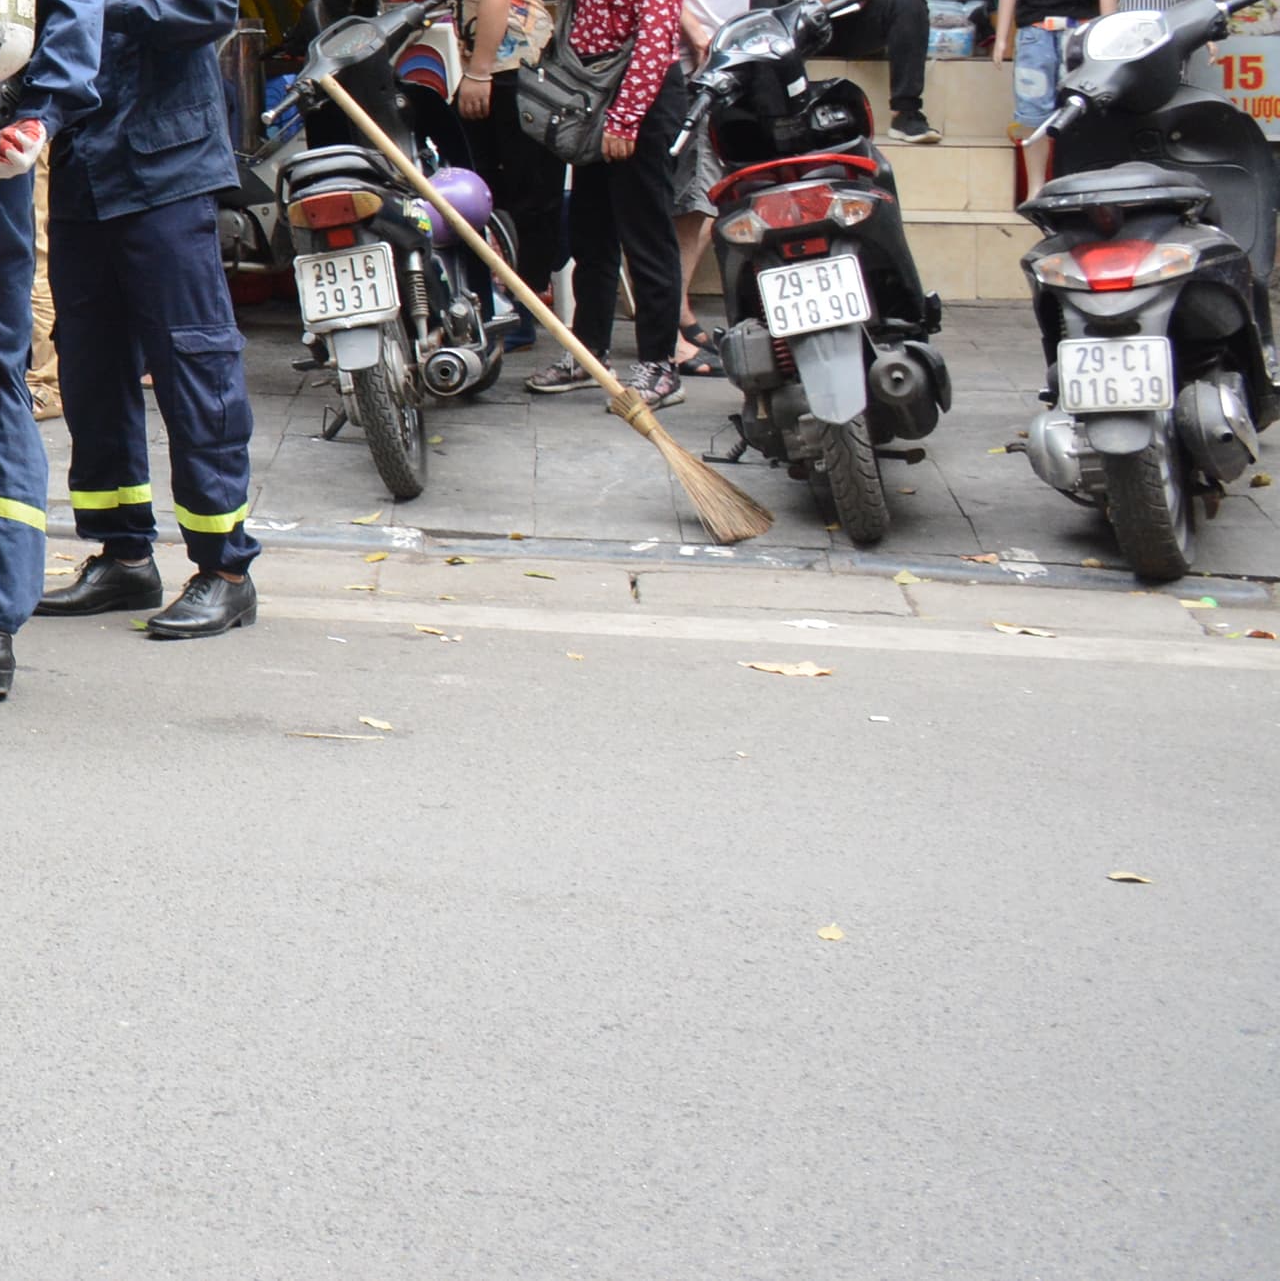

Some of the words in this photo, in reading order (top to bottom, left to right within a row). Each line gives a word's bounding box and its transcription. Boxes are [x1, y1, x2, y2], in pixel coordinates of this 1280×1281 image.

[1216, 55, 1264, 90] 15
[312, 254, 376, 288] 29-L6
[775, 263, 843, 300] 29-B1
[316, 283, 380, 315] 3931
[773, 292, 861, 331] 918.90
[1075, 344, 1151, 375] 29-C1
[1069, 377, 1163, 407] 016.39
